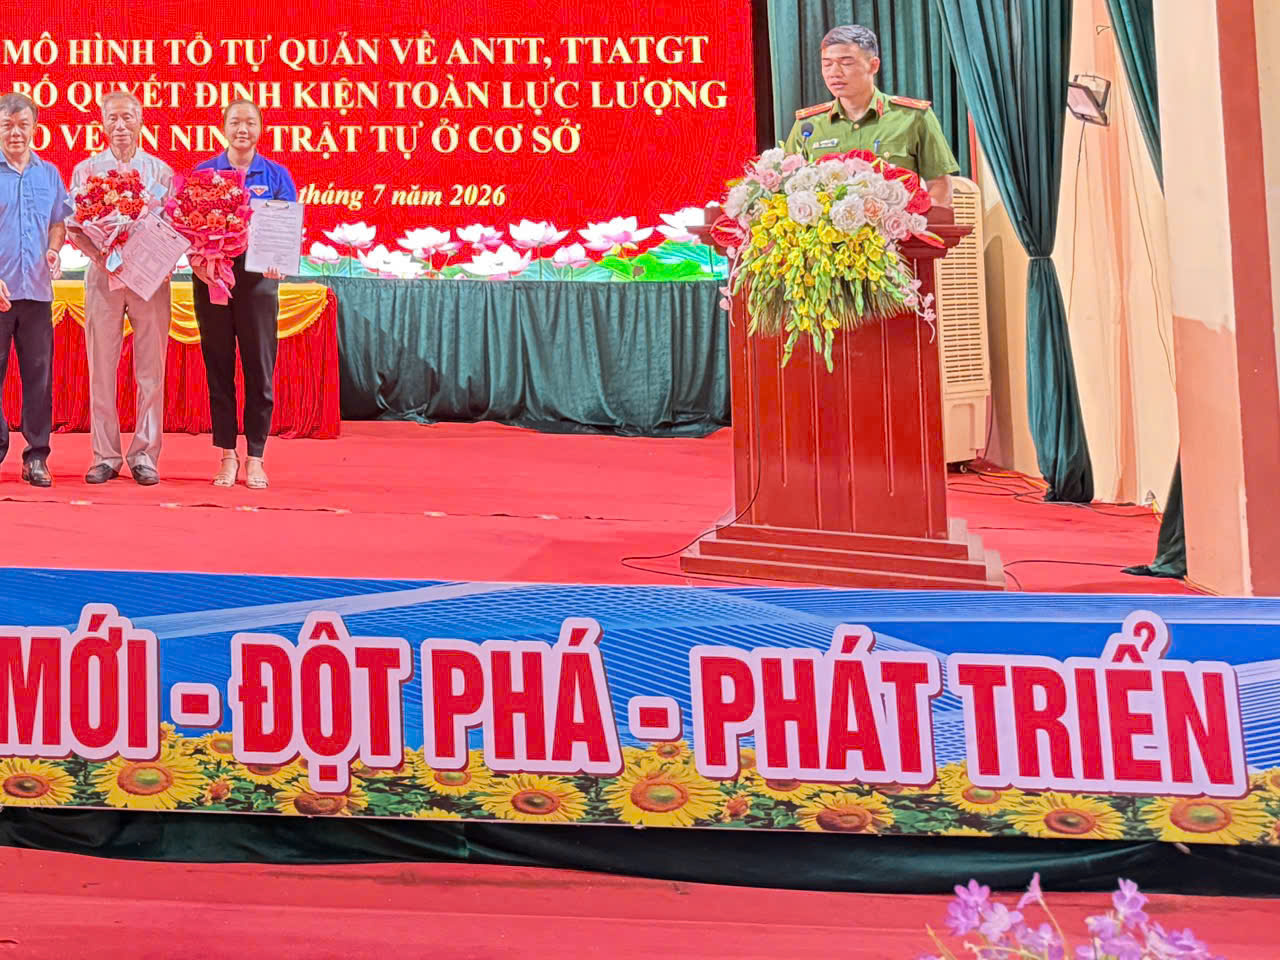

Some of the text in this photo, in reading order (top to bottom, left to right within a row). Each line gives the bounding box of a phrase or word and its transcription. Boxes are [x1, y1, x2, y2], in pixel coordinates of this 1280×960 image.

[2, 30, 60, 66] MÔ
[68, 31, 156, 66] HÌNH
[219, 34, 274, 73] TỰ
[278, 30, 380, 72] QUẢN
[388, 29, 439, 66] VỀ
[445, 36, 553, 70] ANTT,
[559, 34, 710, 66] TTATGT
[292, 76, 380, 117] KIỆN
[387, 72, 490, 110] TOÀN
[501, 75, 580, 117] LỰC
[590, 74, 729, 117] LƯỢNG
[169, 124, 231, 153] NIN
[265, 120, 364, 161] TRẬT
[369, 119, 425, 162] TỰ
[430, 117, 461, 154] Ở
[467, 122, 525, 154] CƠ
[530, 117, 583, 155] SỞ
[297, 182, 507, 212] tháng 7 năm 2026
[238, 621, 401, 782] ĐỘT
[431, 625, 610, 763] PHÁ
[700, 631, 929, 773] PHÁT
[958, 621, 1234, 785] TRIỂN
